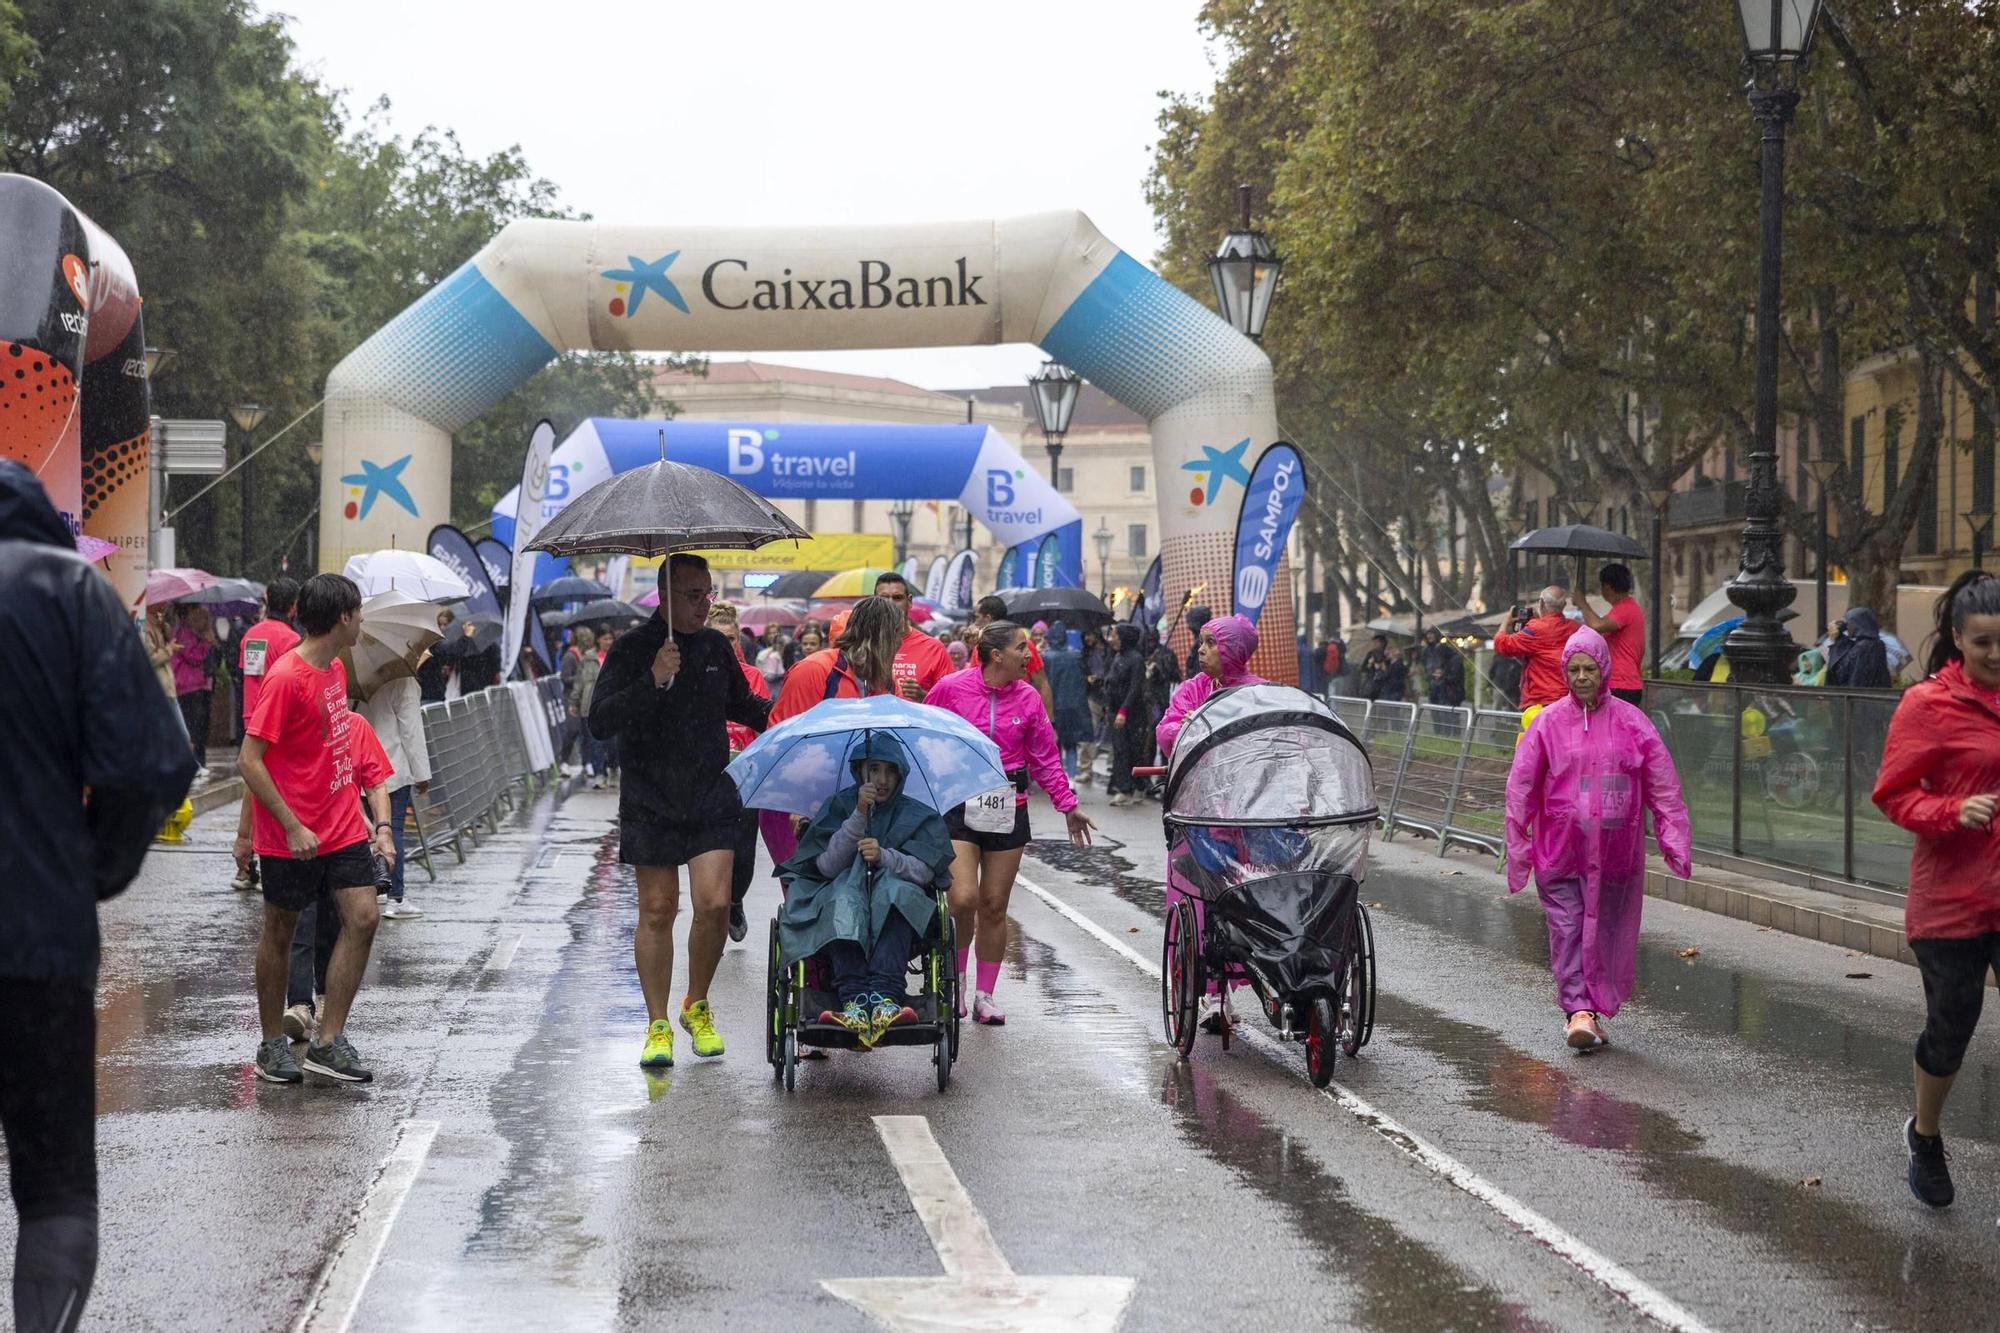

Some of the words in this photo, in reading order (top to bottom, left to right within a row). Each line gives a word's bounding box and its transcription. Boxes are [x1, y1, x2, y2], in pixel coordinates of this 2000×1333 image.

[702, 256, 988, 311] CaixaBank
[728, 428, 765, 475] B
[770, 450, 857, 477] travel
[986, 469, 1015, 508] B
[1254, 459, 1295, 561] SAMPOL
[986, 507, 1043, 525] travel
[976, 795, 1005, 810] 1481
